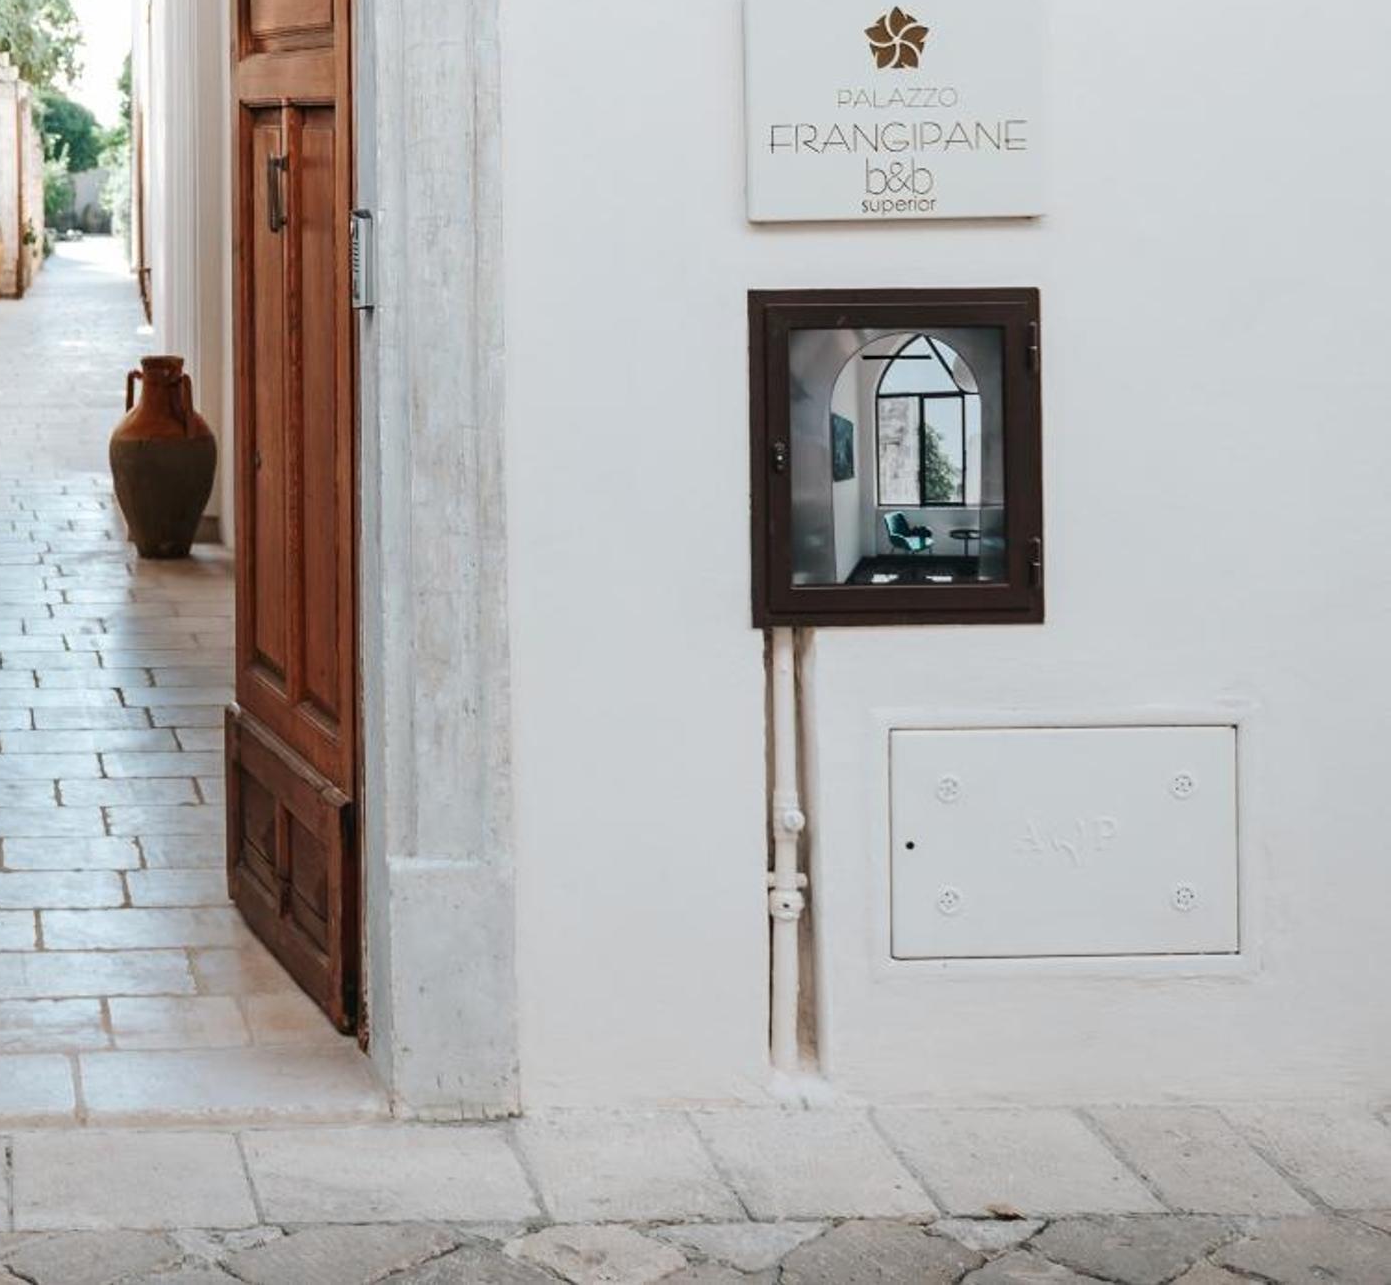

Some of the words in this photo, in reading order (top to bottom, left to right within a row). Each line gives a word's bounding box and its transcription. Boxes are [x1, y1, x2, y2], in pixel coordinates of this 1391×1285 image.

[837, 86, 959, 109] PALAZZO
[768, 119, 1028, 154] FRANGIPANE
[865, 157, 935, 195] b&b
[861, 195, 937, 215] superior
